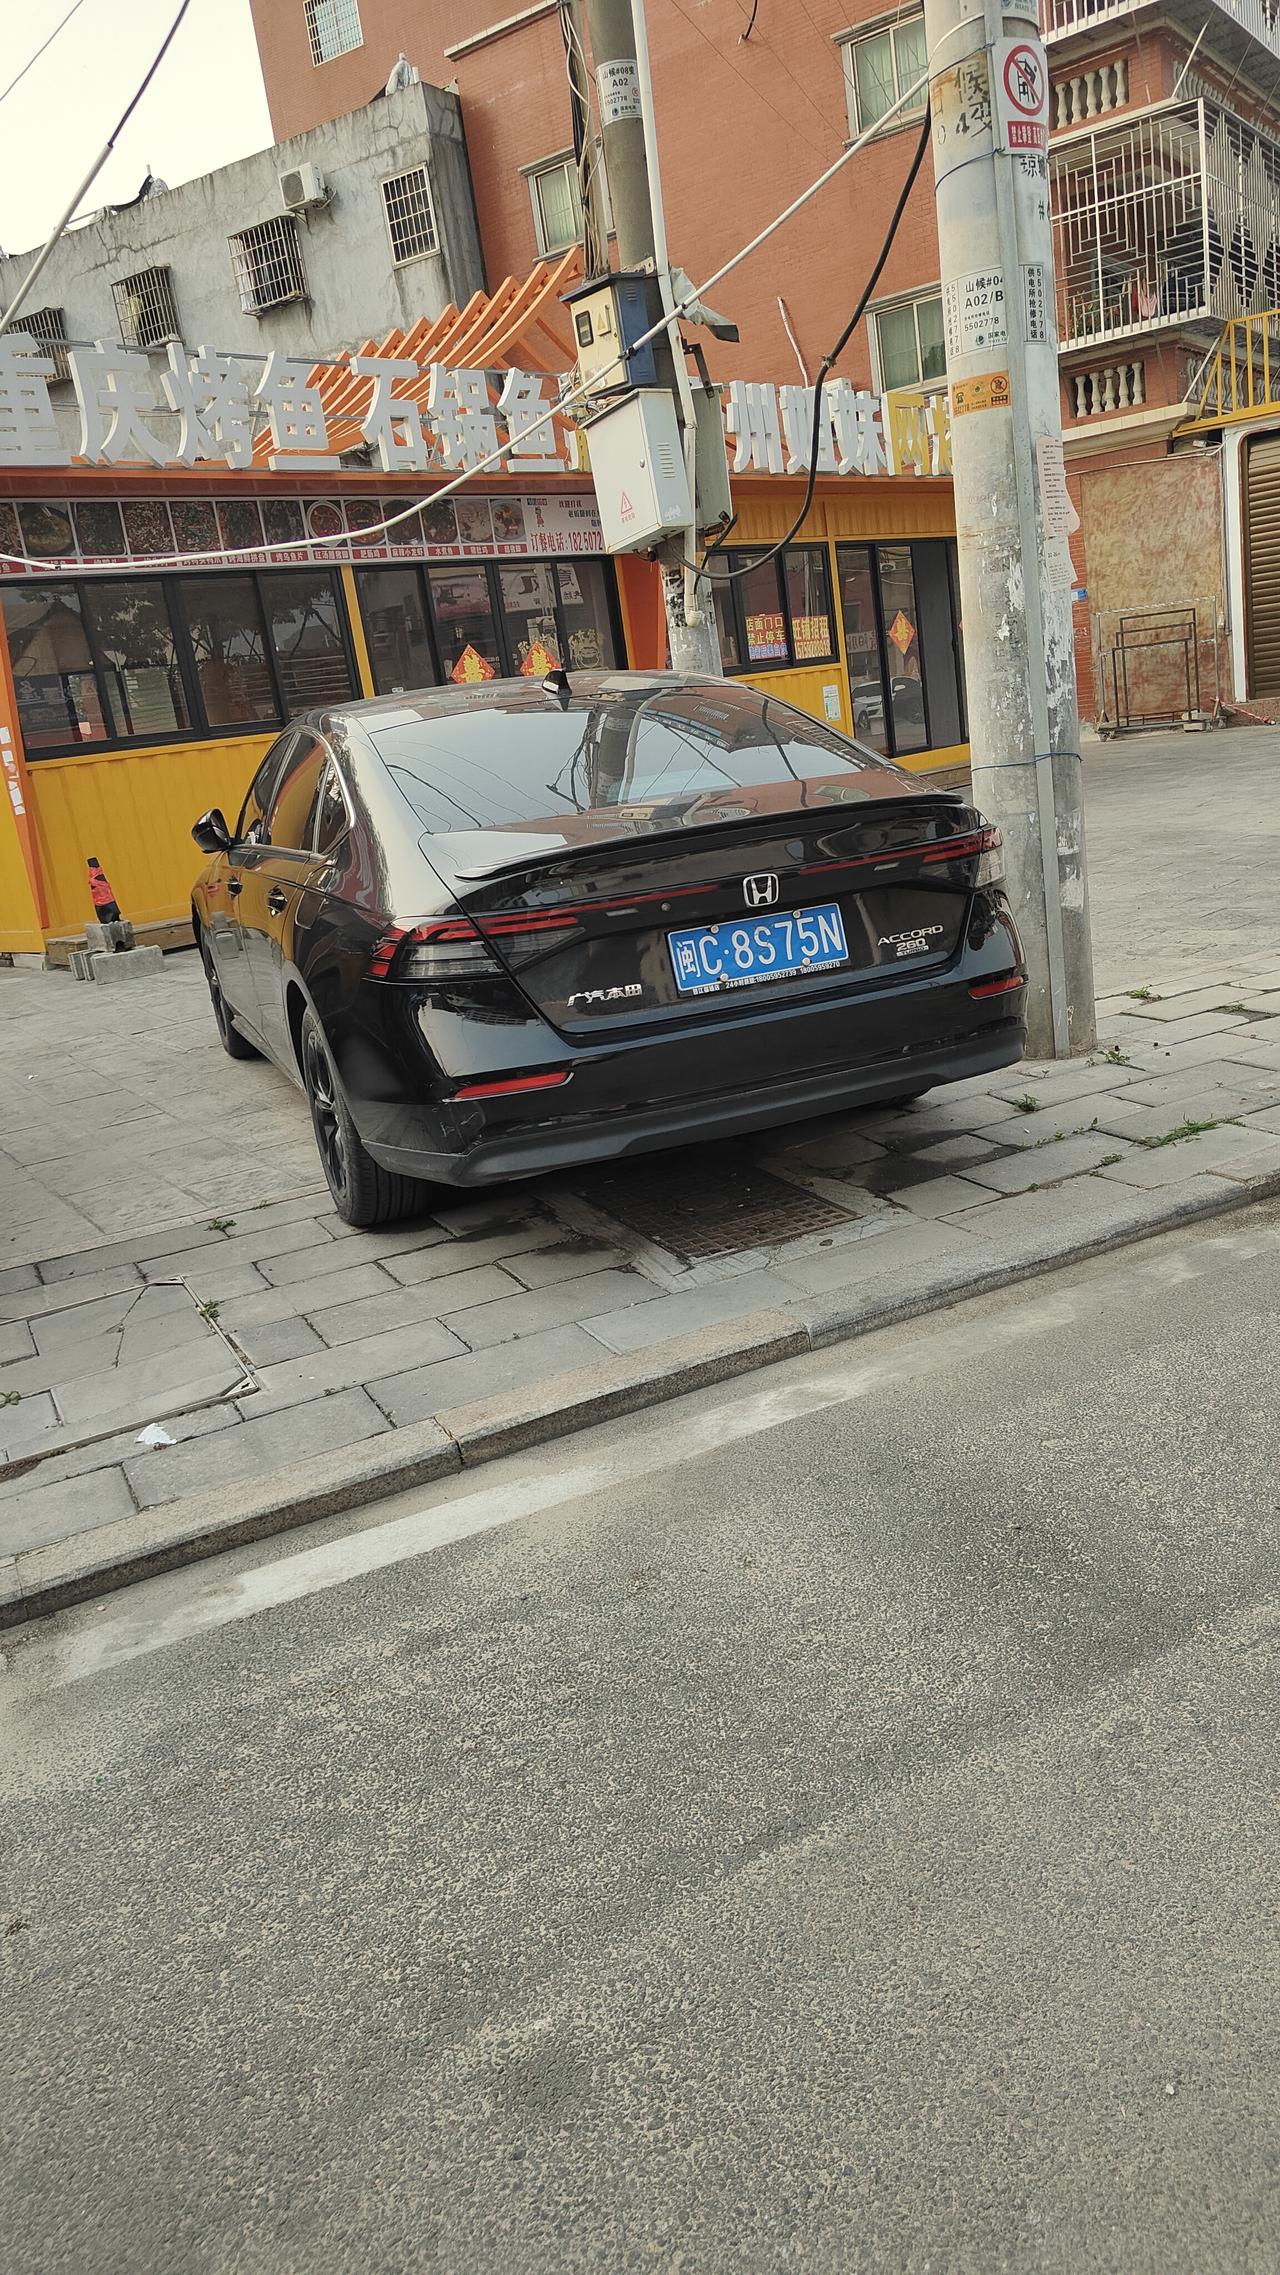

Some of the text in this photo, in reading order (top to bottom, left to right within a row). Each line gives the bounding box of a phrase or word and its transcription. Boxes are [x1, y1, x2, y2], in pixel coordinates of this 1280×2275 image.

[612, 78, 629, 88] A02
[1036, 268, 1044, 339] 5502778
[950, 284, 960, 353] 5502778
[964, 316, 1000, 332] 5502778
[746, 616, 783, 631] 店面门口
[747, 630, 786, 646] 禁止停车
[878, 925, 944, 946] ACCORD
[896, 938, 926, 951] 260
[567, 983, 643, 1006] 广汽本田
